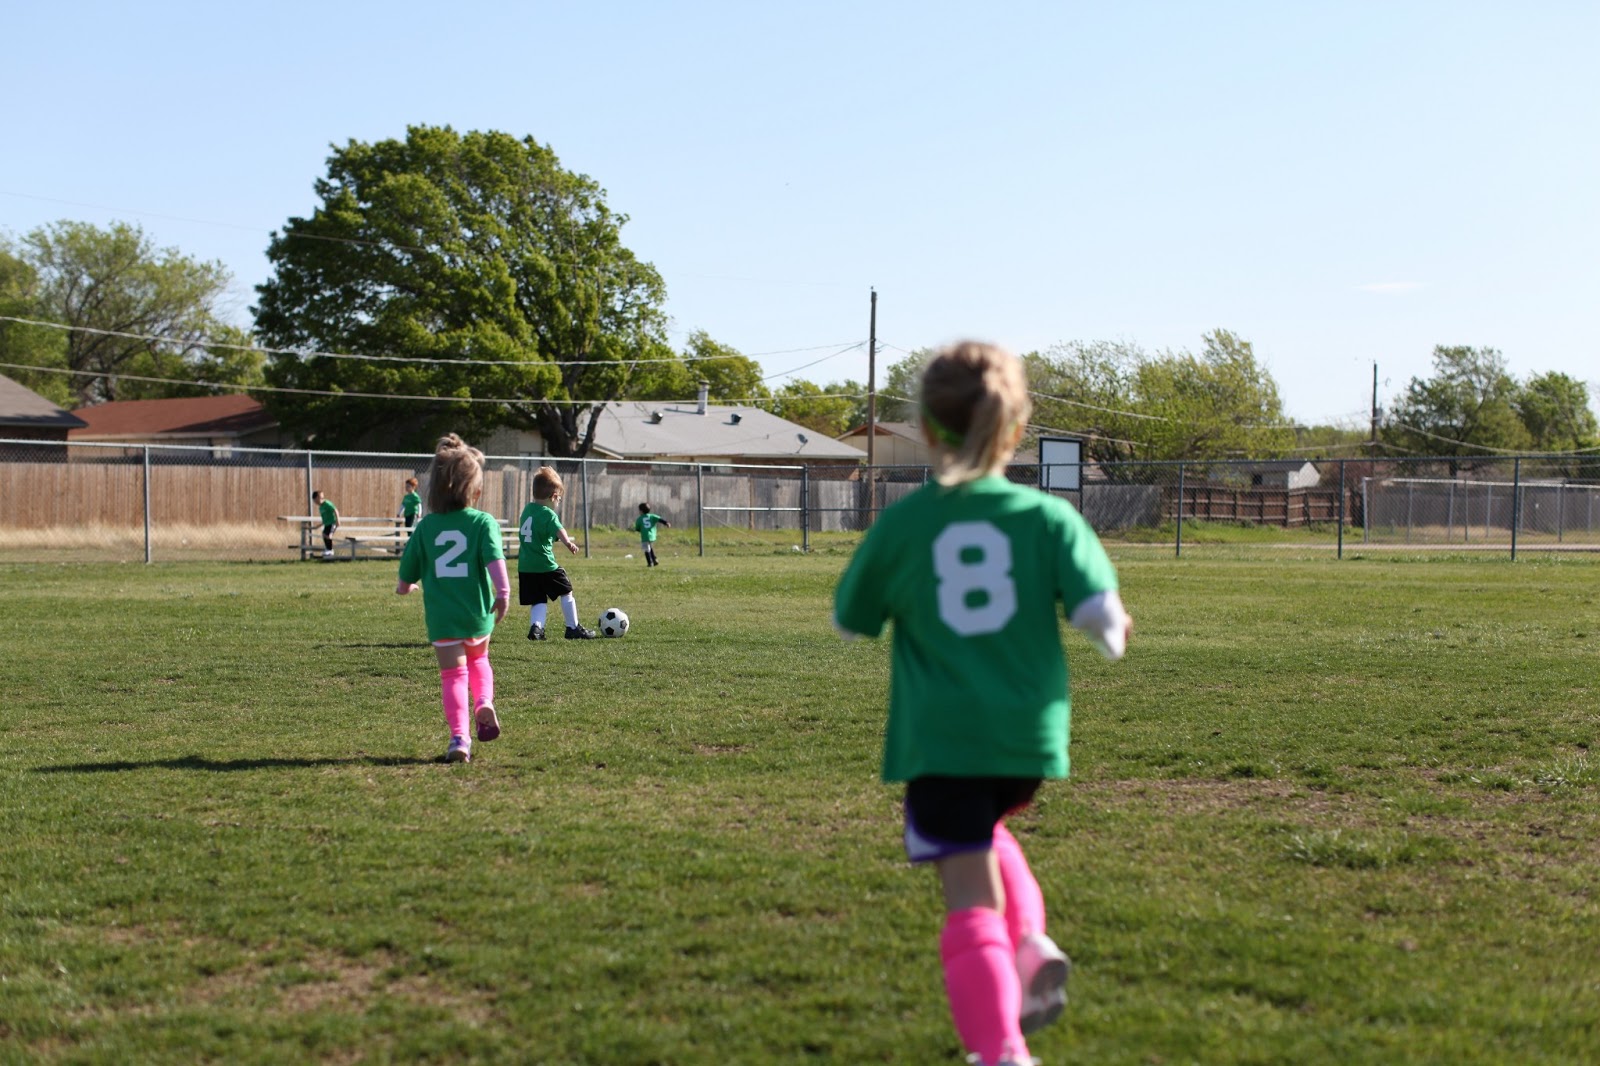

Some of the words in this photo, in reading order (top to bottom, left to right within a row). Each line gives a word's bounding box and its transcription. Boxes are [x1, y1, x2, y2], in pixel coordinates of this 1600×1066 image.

[520, 516, 532, 543] 4
[642, 517, 652, 528] 5
[434, 530, 469, 578] 2
[932, 520, 1018, 636] 8
